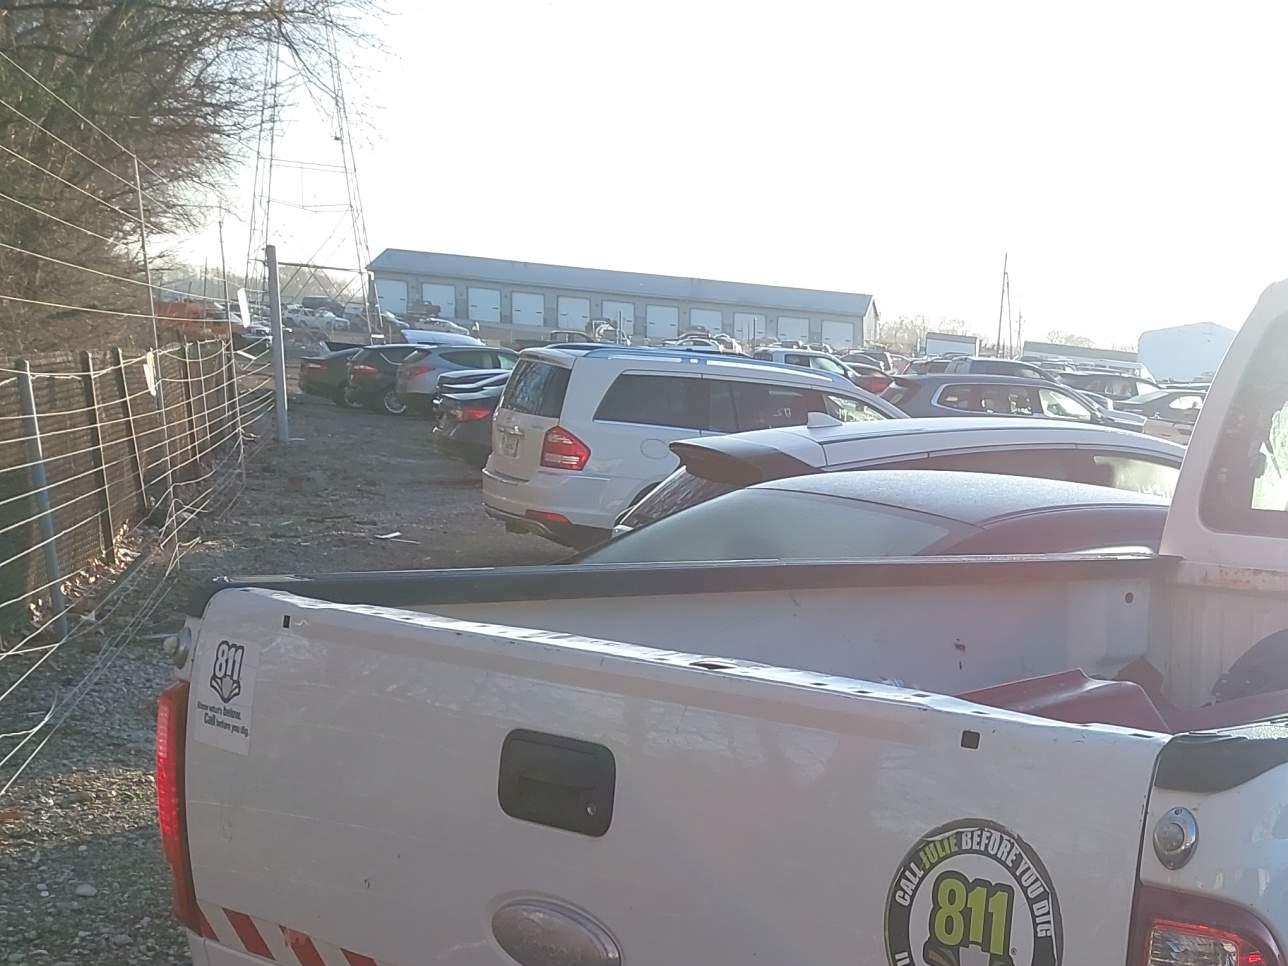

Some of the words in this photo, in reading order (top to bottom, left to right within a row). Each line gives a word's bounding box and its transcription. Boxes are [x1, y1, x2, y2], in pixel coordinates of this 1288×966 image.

[213, 640, 245, 682] 811
[895, 863, 925, 907] CALL
[919, 835, 958, 870] JULIE
[961, 830, 1019, 866] BEFORE
[933, 875, 1011, 956] 811
